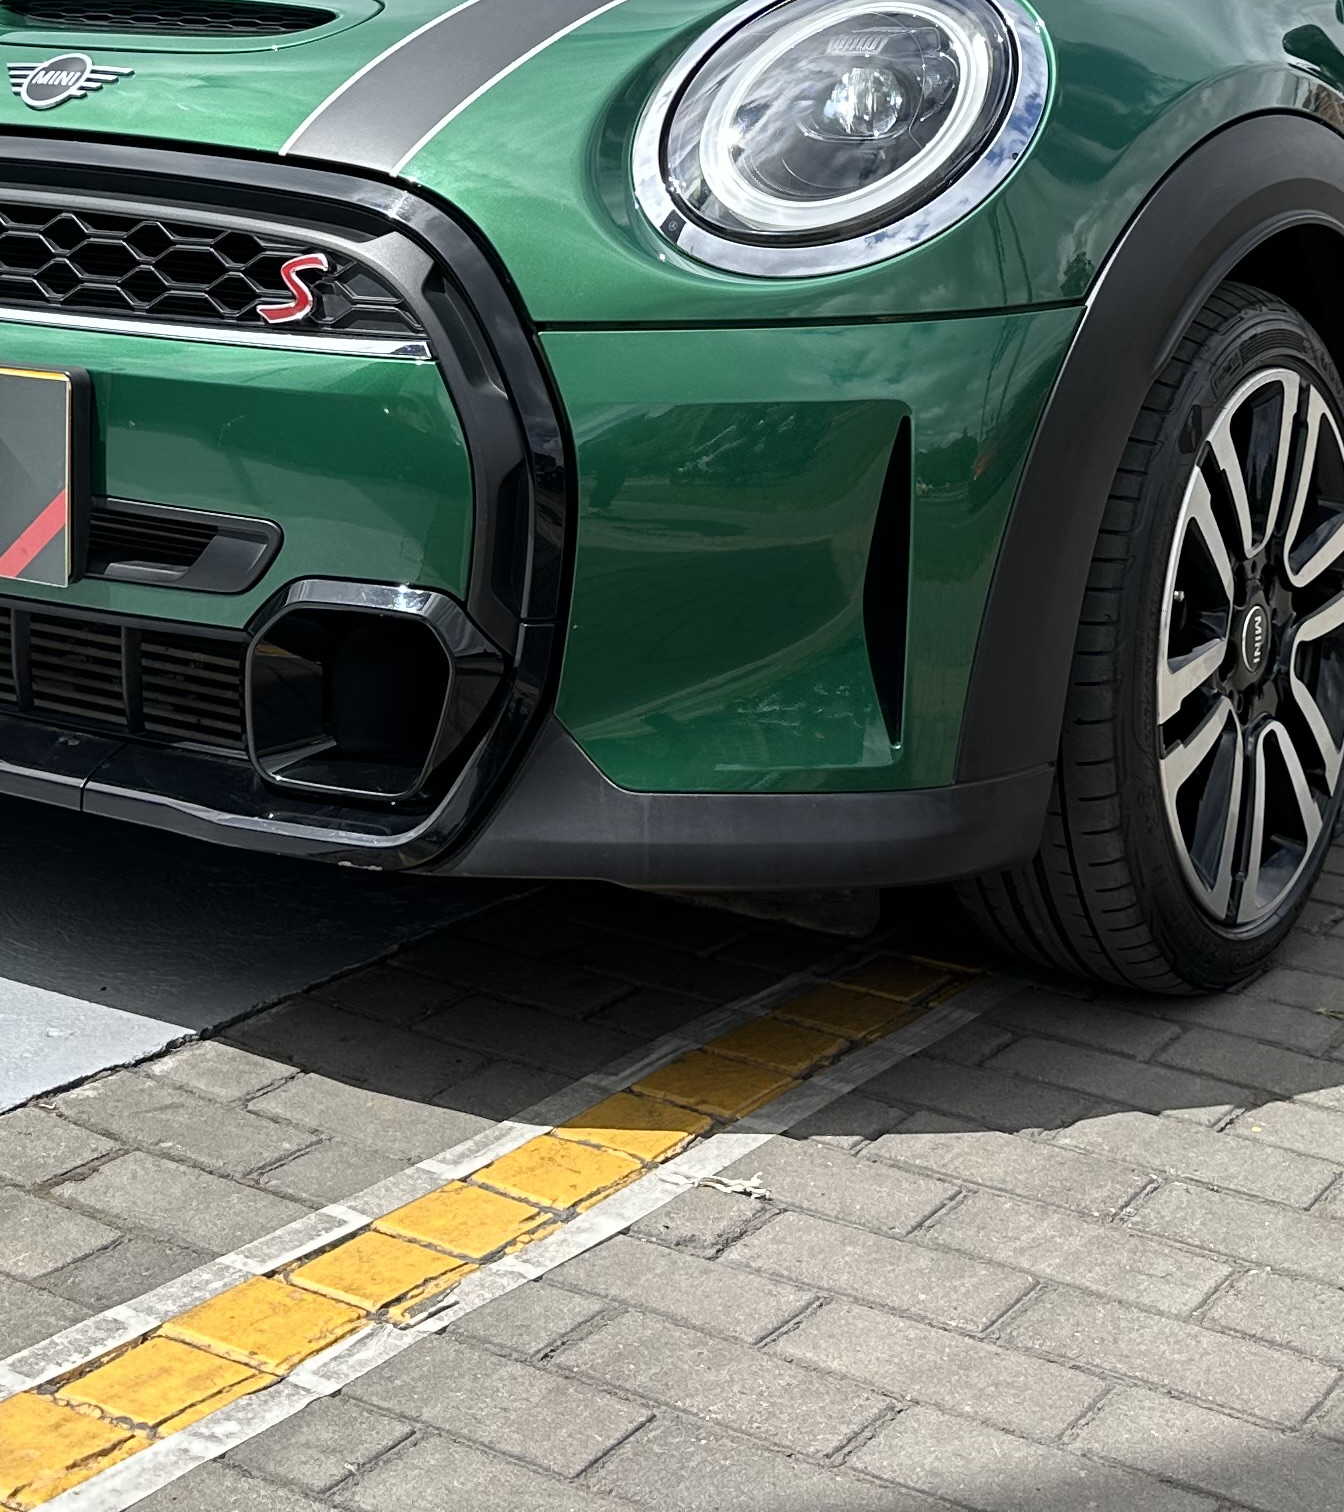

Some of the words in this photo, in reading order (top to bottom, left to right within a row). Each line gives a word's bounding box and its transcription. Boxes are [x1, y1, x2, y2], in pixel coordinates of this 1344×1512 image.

[31, 70, 82, 86] MINI
[256, 253, 329, 324] S
[1252, 615, 1263, 664] MINI
